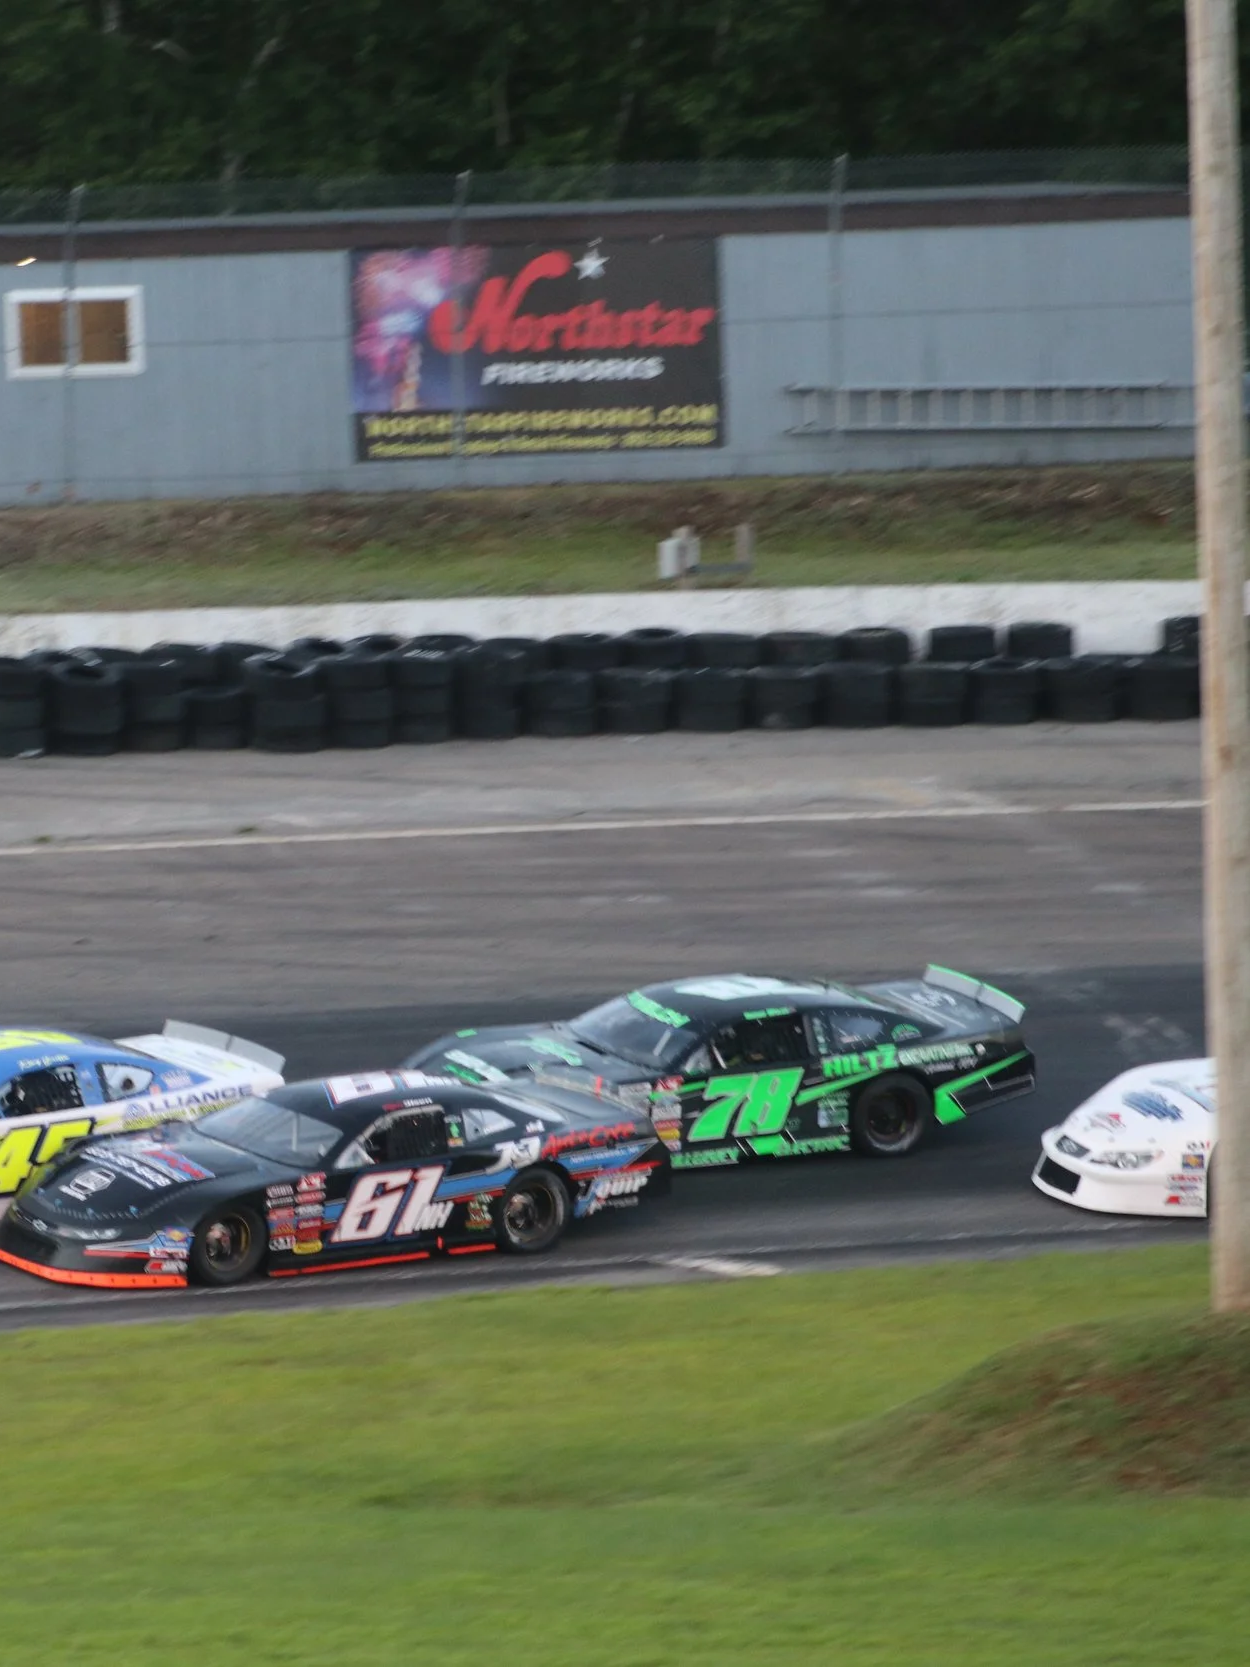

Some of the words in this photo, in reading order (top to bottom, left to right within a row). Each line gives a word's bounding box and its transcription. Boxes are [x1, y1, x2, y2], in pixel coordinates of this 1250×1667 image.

[428, 250, 715, 355] Northstar
[480, 357, 665, 385] FIREWORKS
[688, 1067, 804, 1143] 78
[330, 1163, 447, 1245] 61
